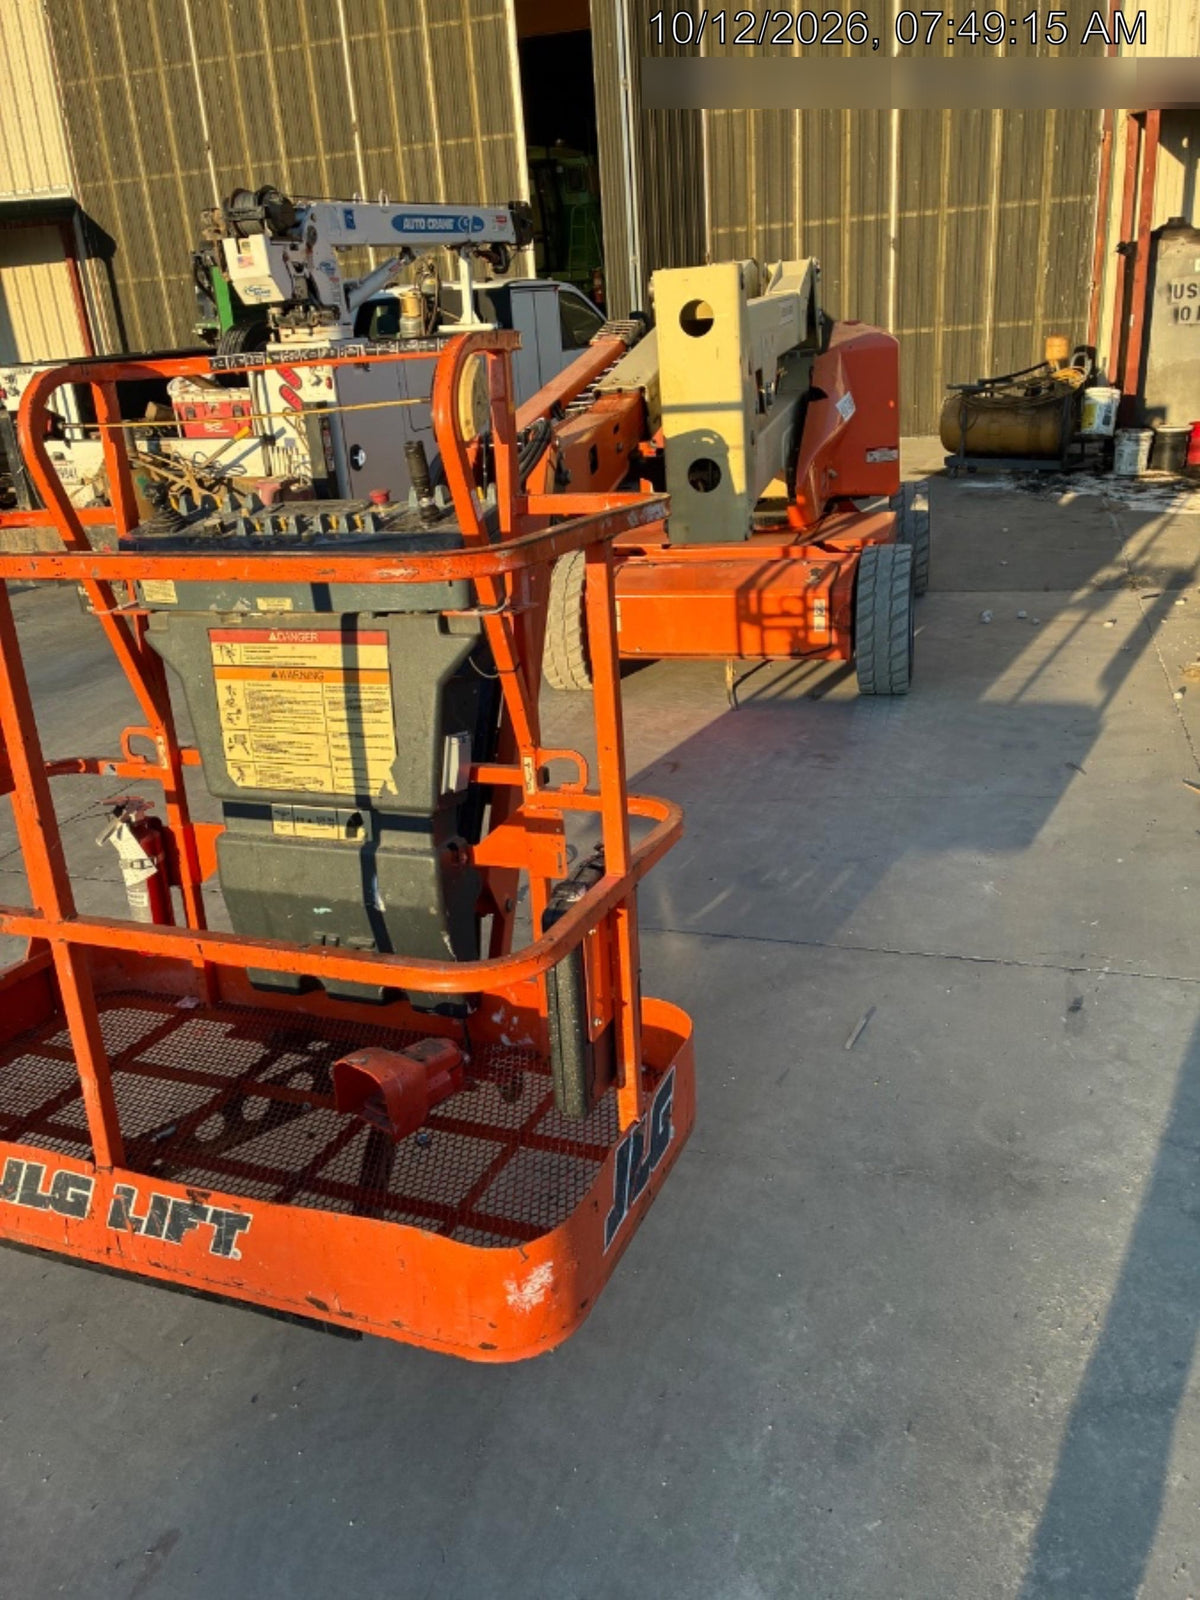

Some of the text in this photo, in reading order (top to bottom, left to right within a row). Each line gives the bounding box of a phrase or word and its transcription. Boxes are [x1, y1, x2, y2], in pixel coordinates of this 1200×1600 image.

[402, 217, 455, 230] AUTO CRANE
[277, 631, 319, 642] DANGER
[278, 669, 325, 681] WARNING
[602, 1065, 676, 1256] JLG
[0, 1157, 253, 1255] JLG LIFT
